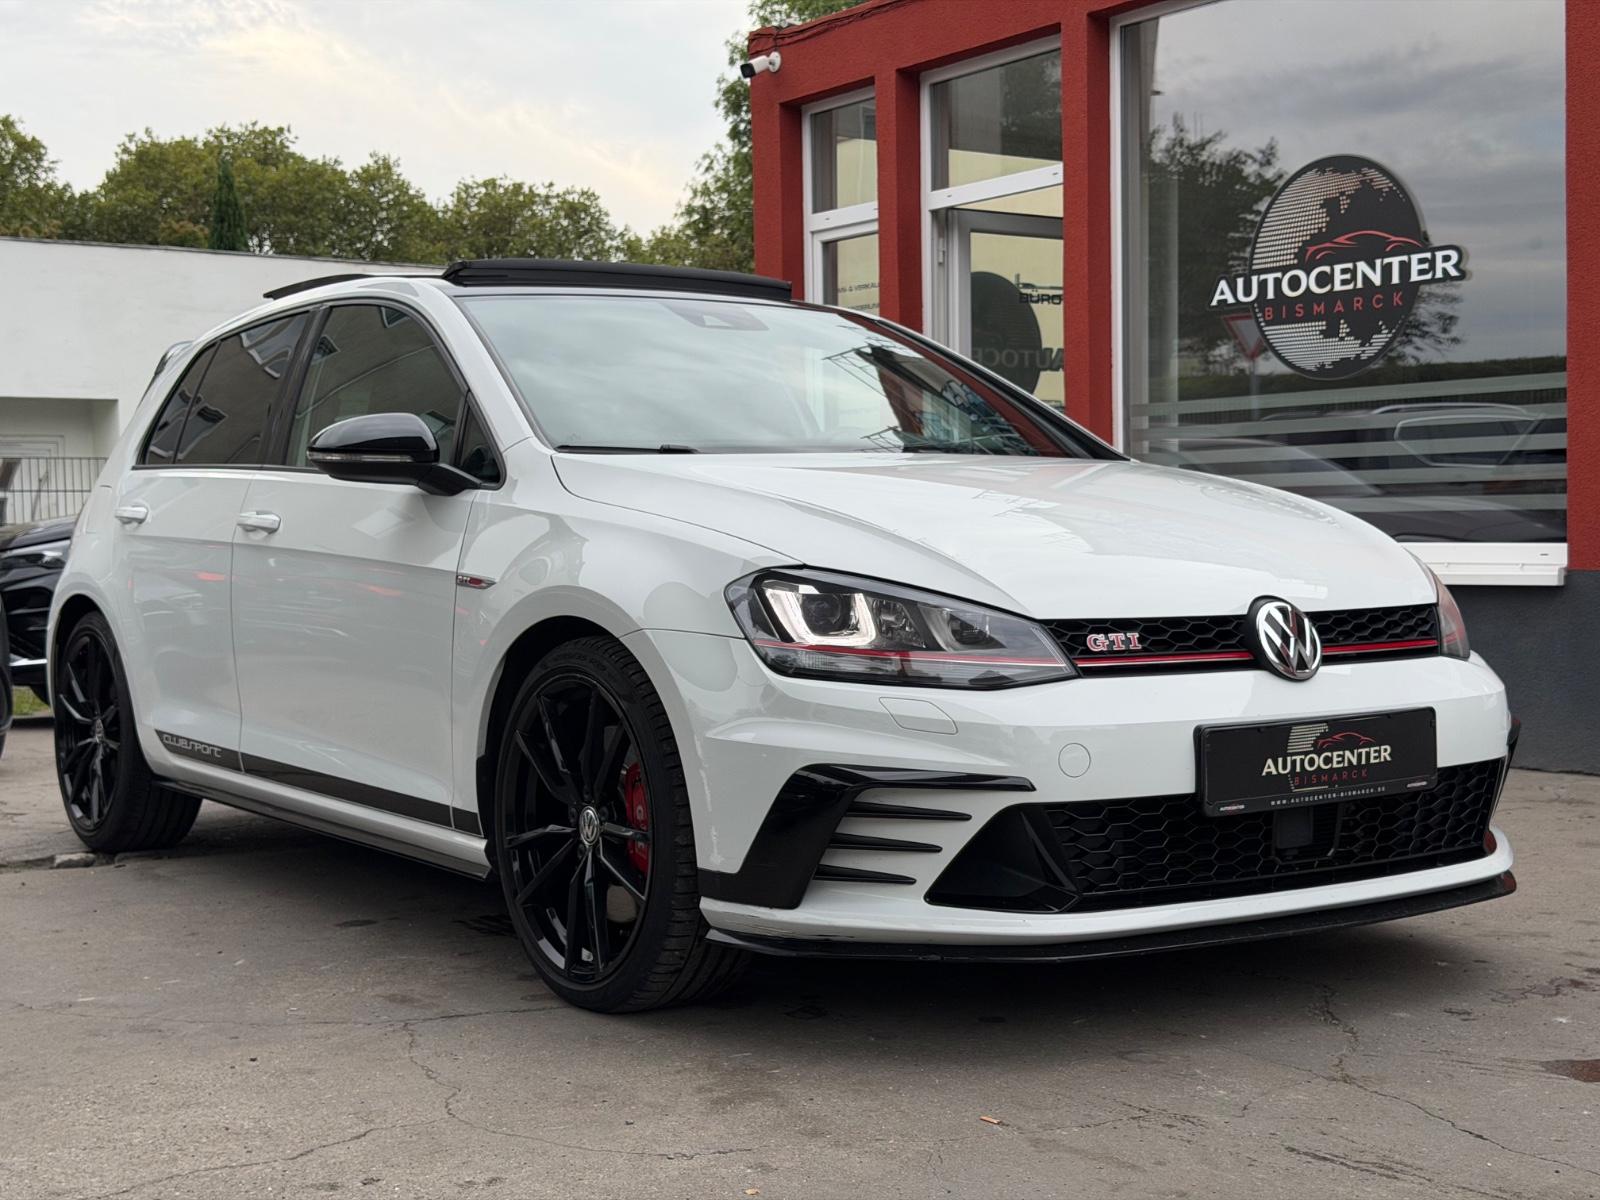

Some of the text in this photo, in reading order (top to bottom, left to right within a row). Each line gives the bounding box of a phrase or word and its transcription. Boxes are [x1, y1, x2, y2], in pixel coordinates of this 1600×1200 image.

[1210, 250, 1461, 307] AUTOCENTER
[1264, 292, 1404, 321] BISMARCK
[1086, 632, 1142, 651] GTI
[1261, 744, 1392, 777] AUTOCENTER
[1294, 769, 1369, 786] BISMARCK
